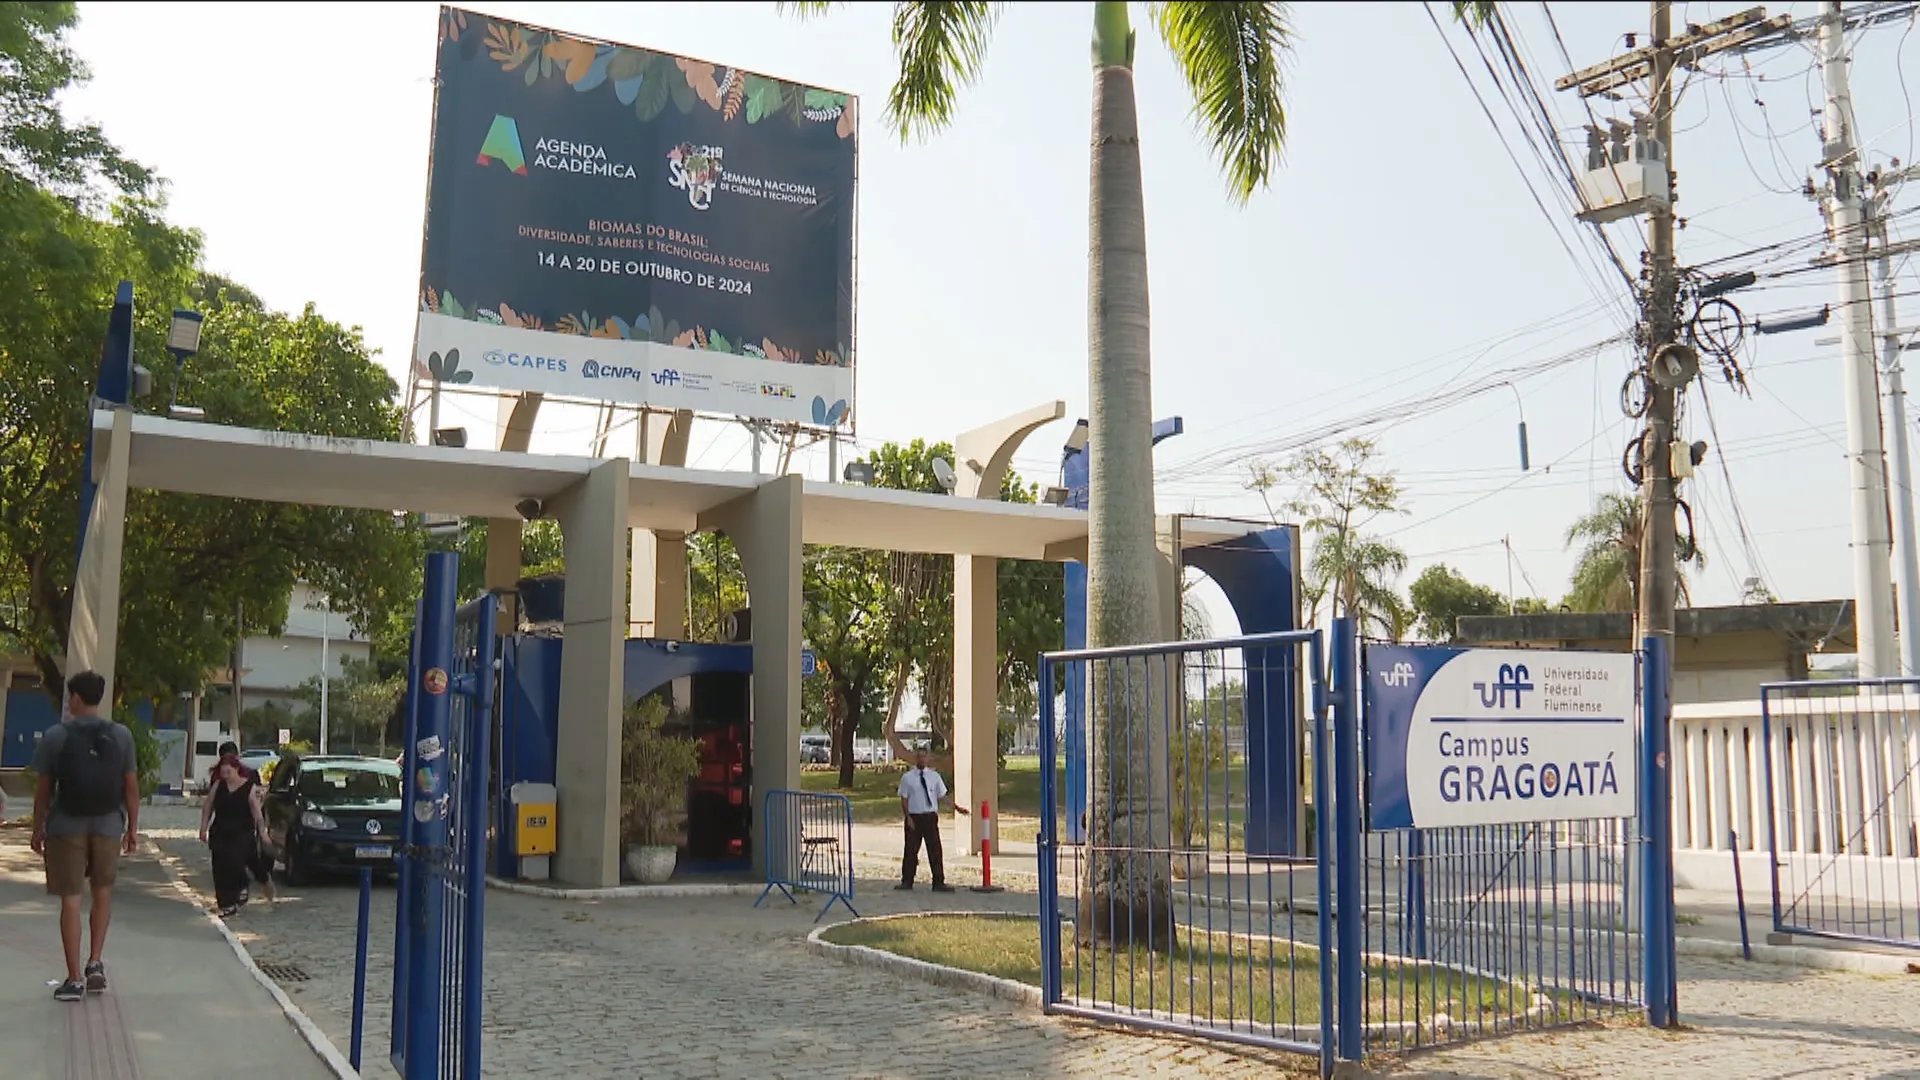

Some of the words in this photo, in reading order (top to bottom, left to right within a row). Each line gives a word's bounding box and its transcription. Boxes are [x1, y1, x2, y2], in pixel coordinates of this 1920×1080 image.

[535, 137, 606, 160] AGENDA
[534, 153, 637, 178] ACADÊMICA
[720, 182, 730, 191] DE
[731, 184, 761, 198] CIÊNCIA
[768, 191, 817, 205] TECNOLOGIA
[722, 171, 762, 188] SEMANA
[764, 180, 817, 196] NACIONAL
[588, 219, 642, 234] BIOMAS
[646, 224, 665, 237] DO
[668, 228, 709, 248] BRASIL:
[518, 225, 594, 246] DIVERSIDADE,
[597, 236, 645, 250] SABERES
[647, 240, 654, 250] E
[656, 241, 726, 266] TECNOLOGIAS
[728, 256, 770, 273] SOCIAIS
[538, 251, 555, 267] 14
[560, 255, 572, 270] A
[576, 257, 596, 272] 20
[600, 259, 621, 274] DE
[625, 261, 693, 285] OUTUBRO
[697, 273, 715, 289] DE
[718, 277, 752, 295] 2024
[507, 353, 568, 372] CAPES
[600, 365, 641, 382] CNPq
[651, 368, 681, 386] uff
[1380, 662, 1415, 687] uff
[1473, 663, 1534, 709] uff
[1543, 667, 1609, 681] Universidade
[1543, 684, 1582, 697] Federal
[1543, 699, 1602, 713] Fluminense
[1439, 731, 1529, 763] Campus
[1439, 751, 1618, 803] GRAGOATÁ
